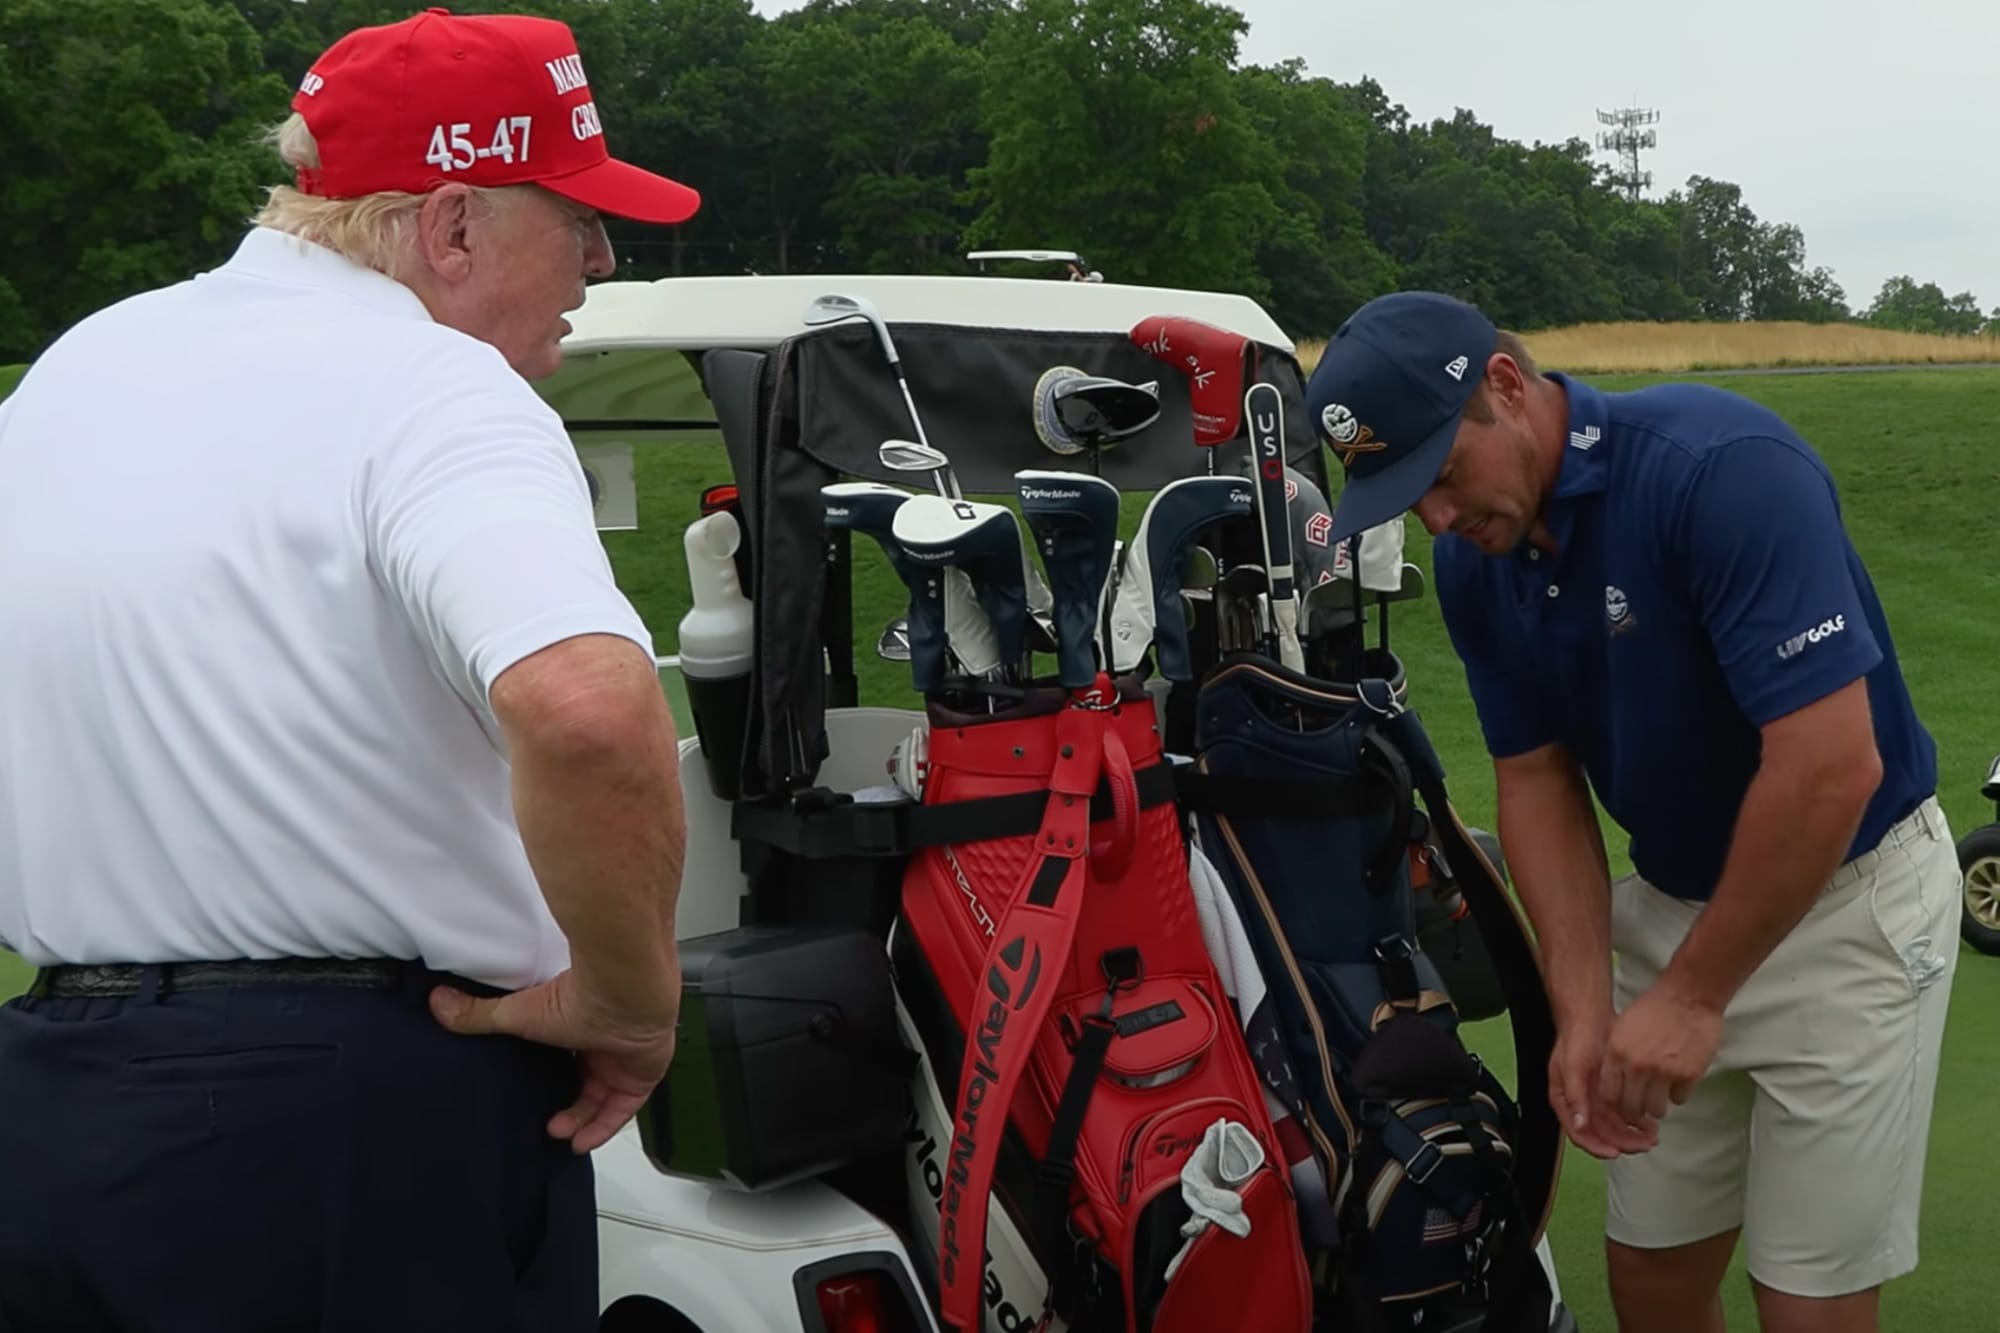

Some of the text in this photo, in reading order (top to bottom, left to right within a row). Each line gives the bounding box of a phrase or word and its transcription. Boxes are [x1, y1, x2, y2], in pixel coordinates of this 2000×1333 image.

[426, 115, 532, 172] 45-47
[1021, 485, 1082, 499] TaylorMade
[1807, 613, 1846, 643] GOLF
[941, 935, 1042, 1290] TaylorMade
